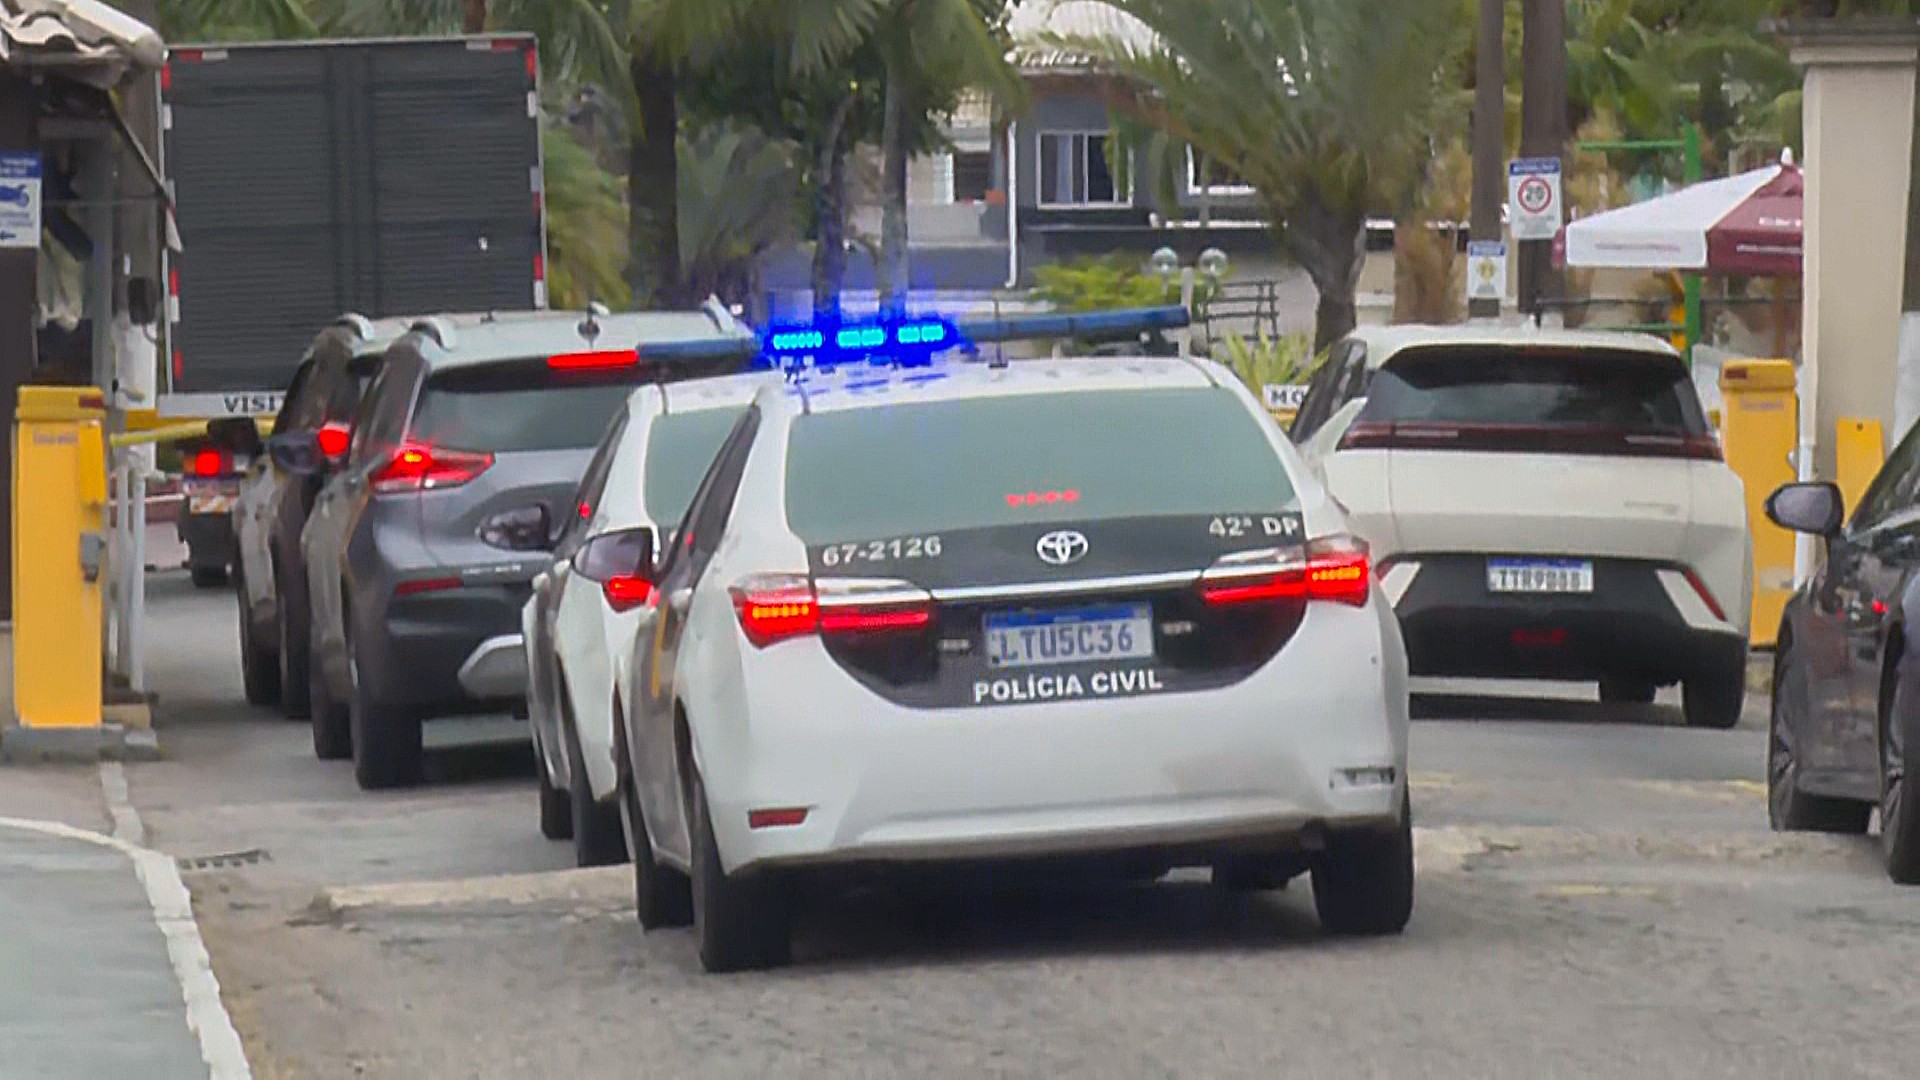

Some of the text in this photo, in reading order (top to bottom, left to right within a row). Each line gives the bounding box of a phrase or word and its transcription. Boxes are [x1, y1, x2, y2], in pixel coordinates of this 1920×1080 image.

[1261, 515, 1299, 537] DP
[822, 534, 942, 567] 67-2126
[999, 621, 1134, 661] LTU5C36
[973, 668, 1164, 704] POLÍCIA CIVIL
